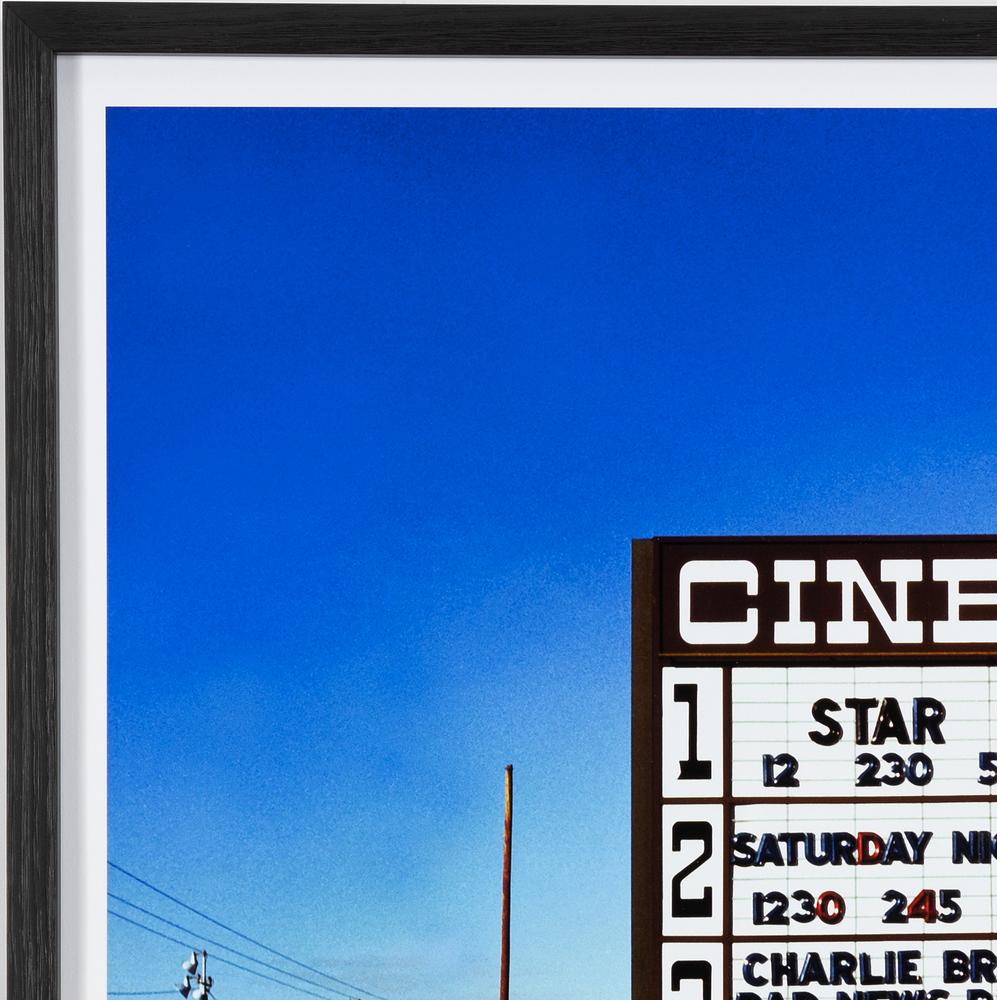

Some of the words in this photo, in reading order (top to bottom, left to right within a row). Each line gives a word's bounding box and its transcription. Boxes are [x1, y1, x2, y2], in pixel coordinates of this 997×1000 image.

[673, 684, 712, 780] 1
[809, 698, 946, 747] STAR
[763, 753, 800, 787] 12
[855, 752, 934, 787] 230
[731, 831, 933, 868] SATURDAY
[672, 821, 713, 917] 2
[752, 890, 846, 925] 1230
[881, 889, 962, 924] 245
[742, 950, 922, 986] CHARLIE
